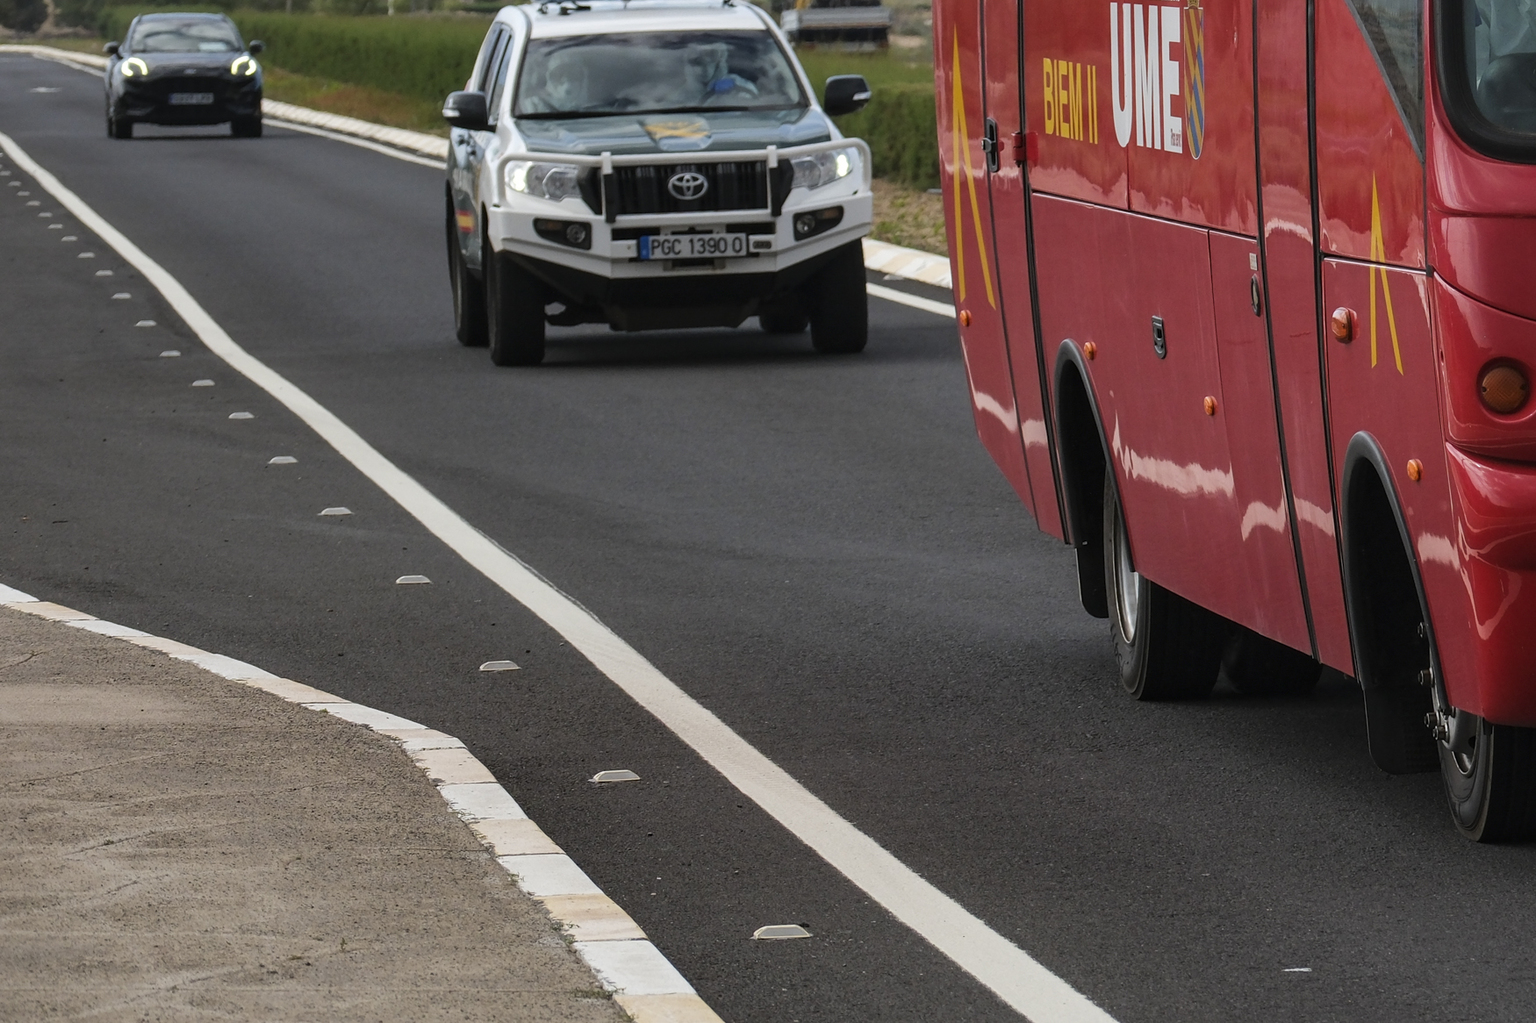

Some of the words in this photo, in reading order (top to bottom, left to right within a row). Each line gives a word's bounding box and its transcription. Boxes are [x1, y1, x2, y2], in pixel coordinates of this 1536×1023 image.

[1043, 57, 1084, 141] BIEM
[1087, 64, 1098, 145] II
[1110, 2, 1183, 154] UME
[651, 238, 682, 256] PGC
[688, 237, 728, 255] 1390
